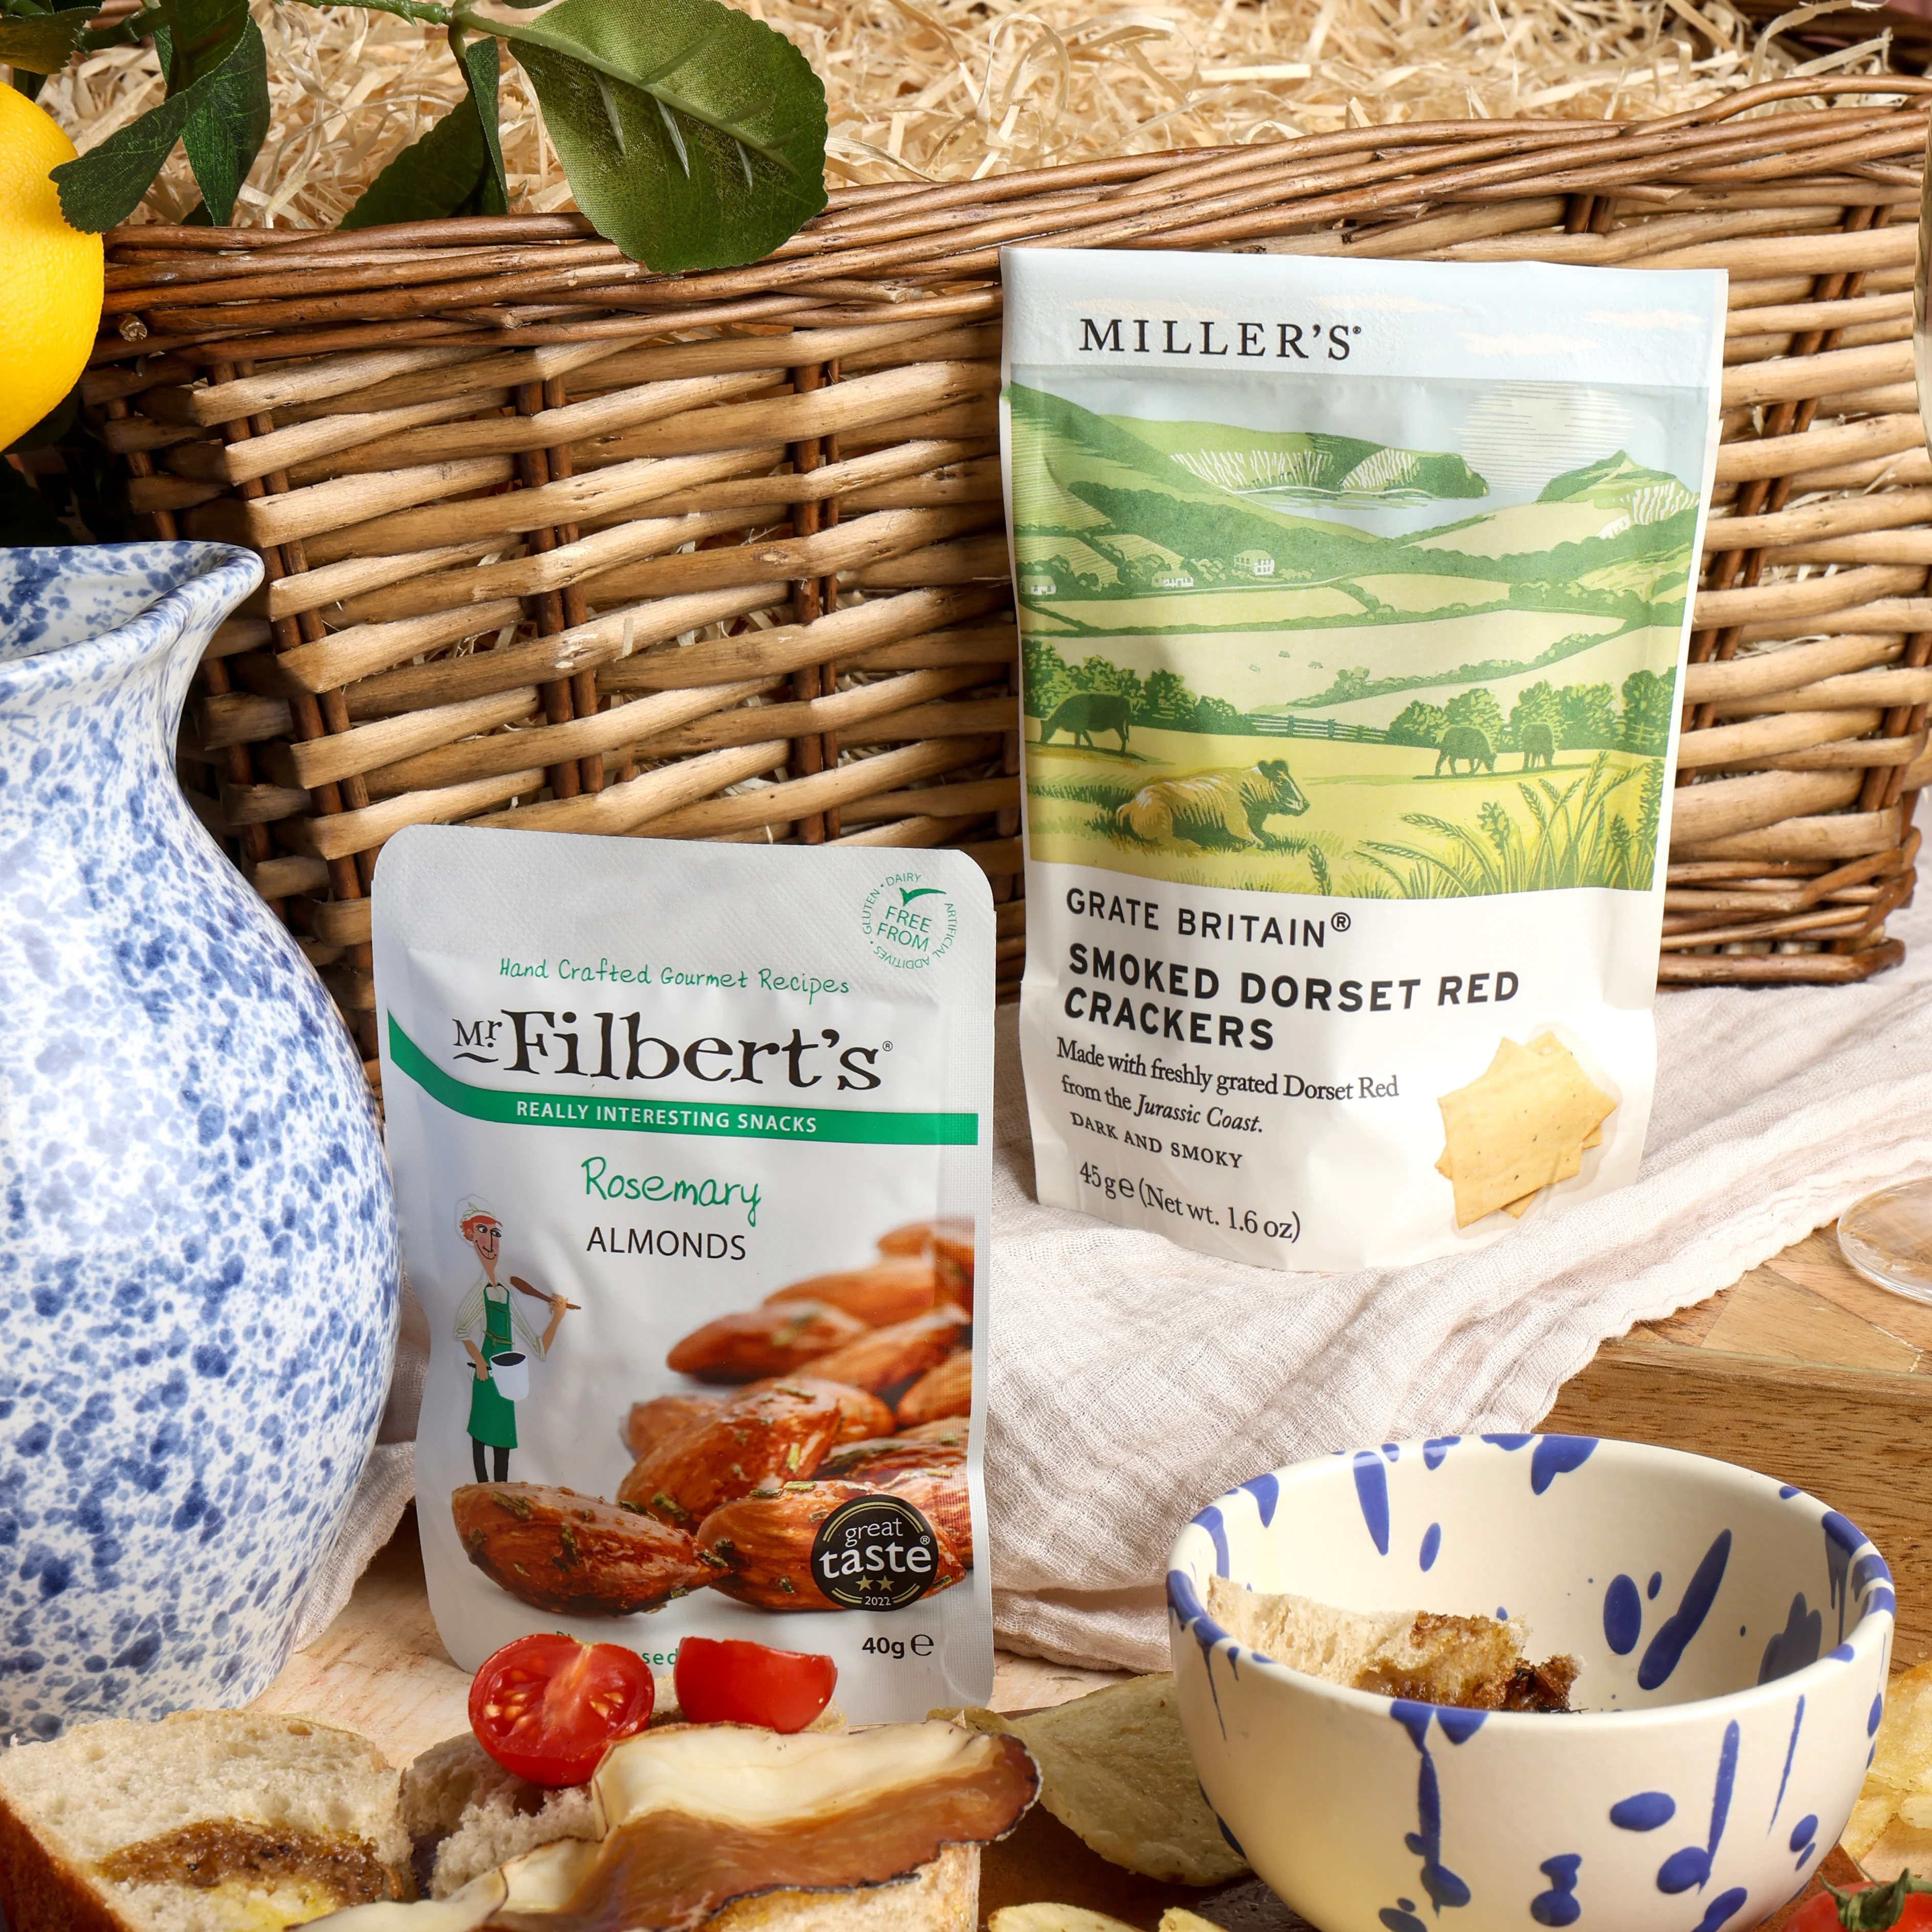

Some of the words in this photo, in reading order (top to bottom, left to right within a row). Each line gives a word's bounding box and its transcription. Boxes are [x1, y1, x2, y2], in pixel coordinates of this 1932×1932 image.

[862, 888, 881, 934] GLUTEN
[885, 872, 922, 886] DAIRY
[885, 906, 932, 933] FREE
[1066, 887, 1159, 931] GRATE
[876, 922, 929, 952] FROM
[931, 903, 957, 958] ARTIFICIAL
[499, 958, 549, 979] Hand
[558, 959, 651, 984] Crafted
[662, 968, 747, 989] Gourmet
[759, 968, 850, 1005] Recipes
[873, 946, 930, 970] ADDITIVES
[1068, 942, 1219, 999] SMOKED
[1241, 972, 1421, 1013] DORSET
[1438, 971, 1519, 1006] RED
[1064, 987, 1274, 1050] CRACKERS
[1057, 1037, 1105, 1067] Made
[1109, 1054, 1146, 1076] with
[1151, 1058, 1213, 1094] freshly
[1216, 1073, 1278, 1095] grated
[1283, 1074, 1354, 1100] Dorset
[1358, 1075, 1400, 1099] Red
[517, 1100, 589, 1119] REALLY
[596, 1105, 731, 1129] INTERESTING
[737, 1112, 818, 1133] SNACKS
[1061, 1075, 1101, 1102] from
[1104, 1088, 1132, 1110] the
[1133, 1094, 1201, 1124] Jurassic
[1206, 1107, 1263, 1133] Coast.
[1070, 1112, 1118, 1140] DARK
[1124, 1130, 1162, 1153] AND
[1170, 1142, 1243, 1169] SMOKY
[581, 1156, 762, 1227] Rosemary
[1138, 1178, 1183, 1217] (Net
[1187, 1204, 1220, 1226] wt.
[1228, 1206, 1259, 1234] 1.6
[1263, 1211, 1301, 1243] oz)
[586, 1226, 747, 1261] ALMONDS
[845, 1518, 904, 1548] great
[865, 1596, 891, 1606] 2022
